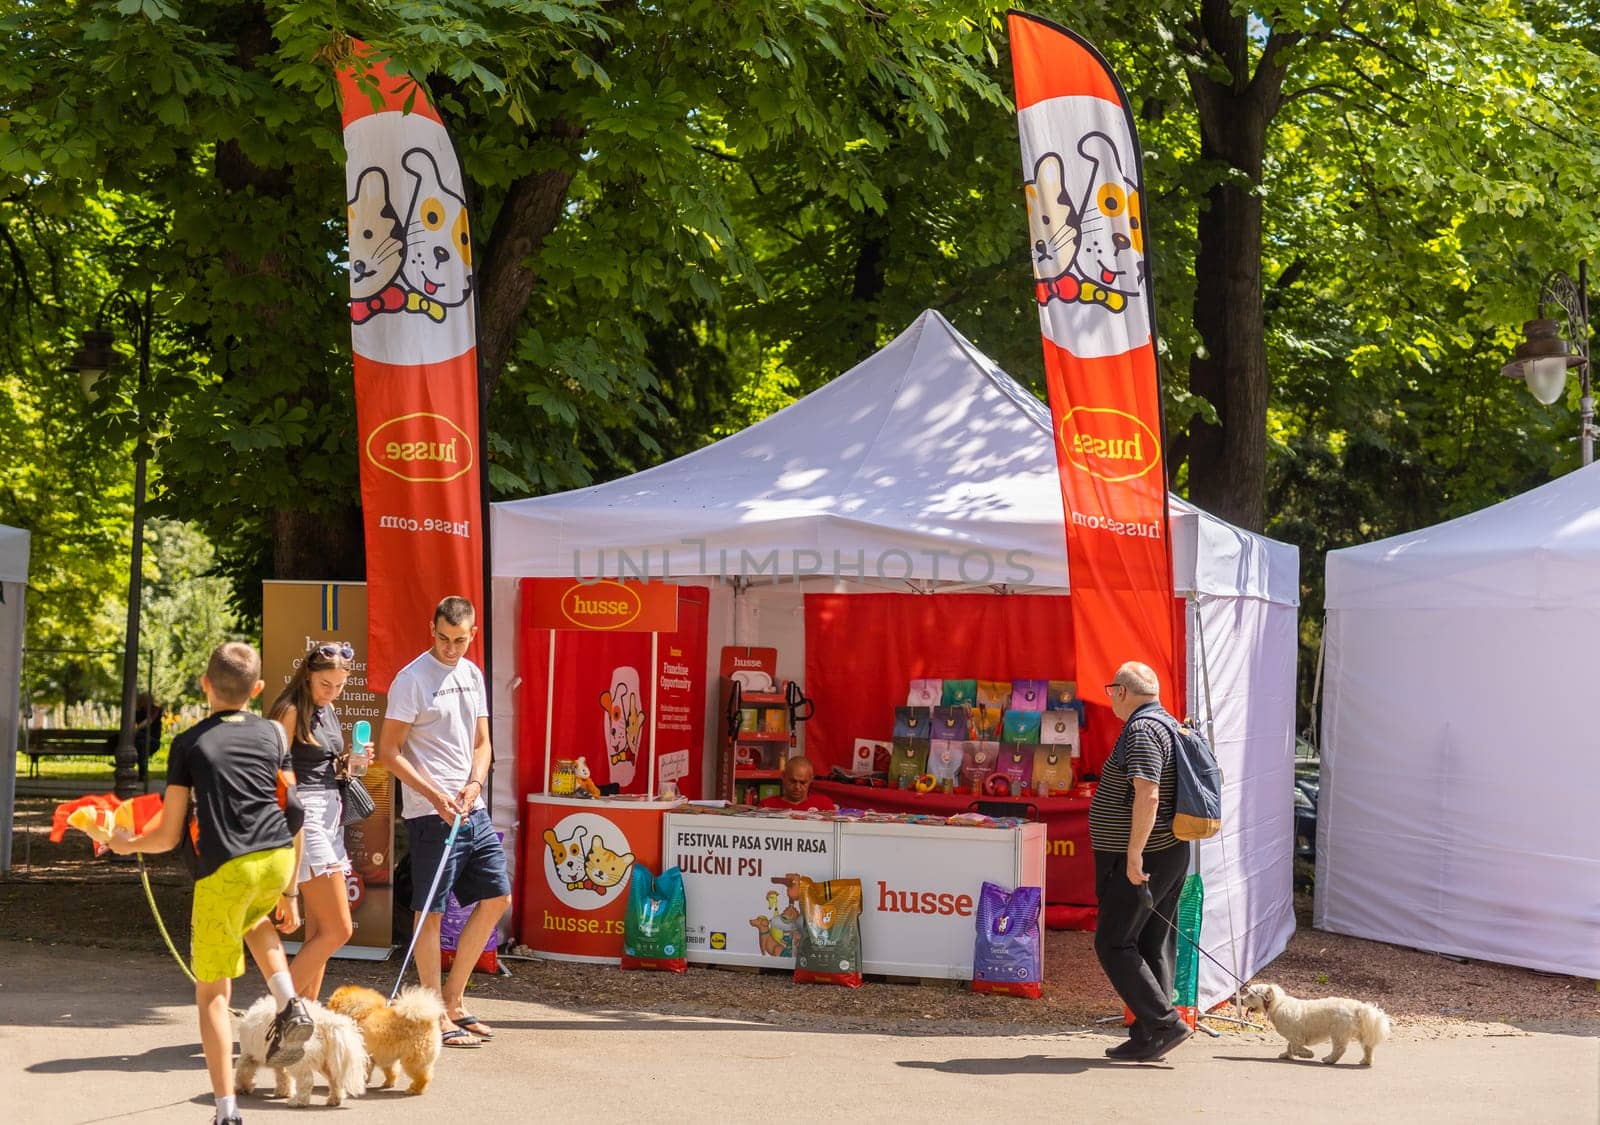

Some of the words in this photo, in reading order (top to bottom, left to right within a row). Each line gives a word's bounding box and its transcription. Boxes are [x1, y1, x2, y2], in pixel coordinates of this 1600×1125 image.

[574, 595, 630, 615] husse
[343, 690, 375, 702] hrane
[677, 832, 728, 849] FESTIVAL
[732, 834, 761, 850] PASA
[765, 836, 793, 853] SVIH
[797, 838, 827, 854] RASA
[678, 849, 732, 876] ULIČNI
[738, 857, 763, 878] PSI
[877, 881, 972, 917] husse
